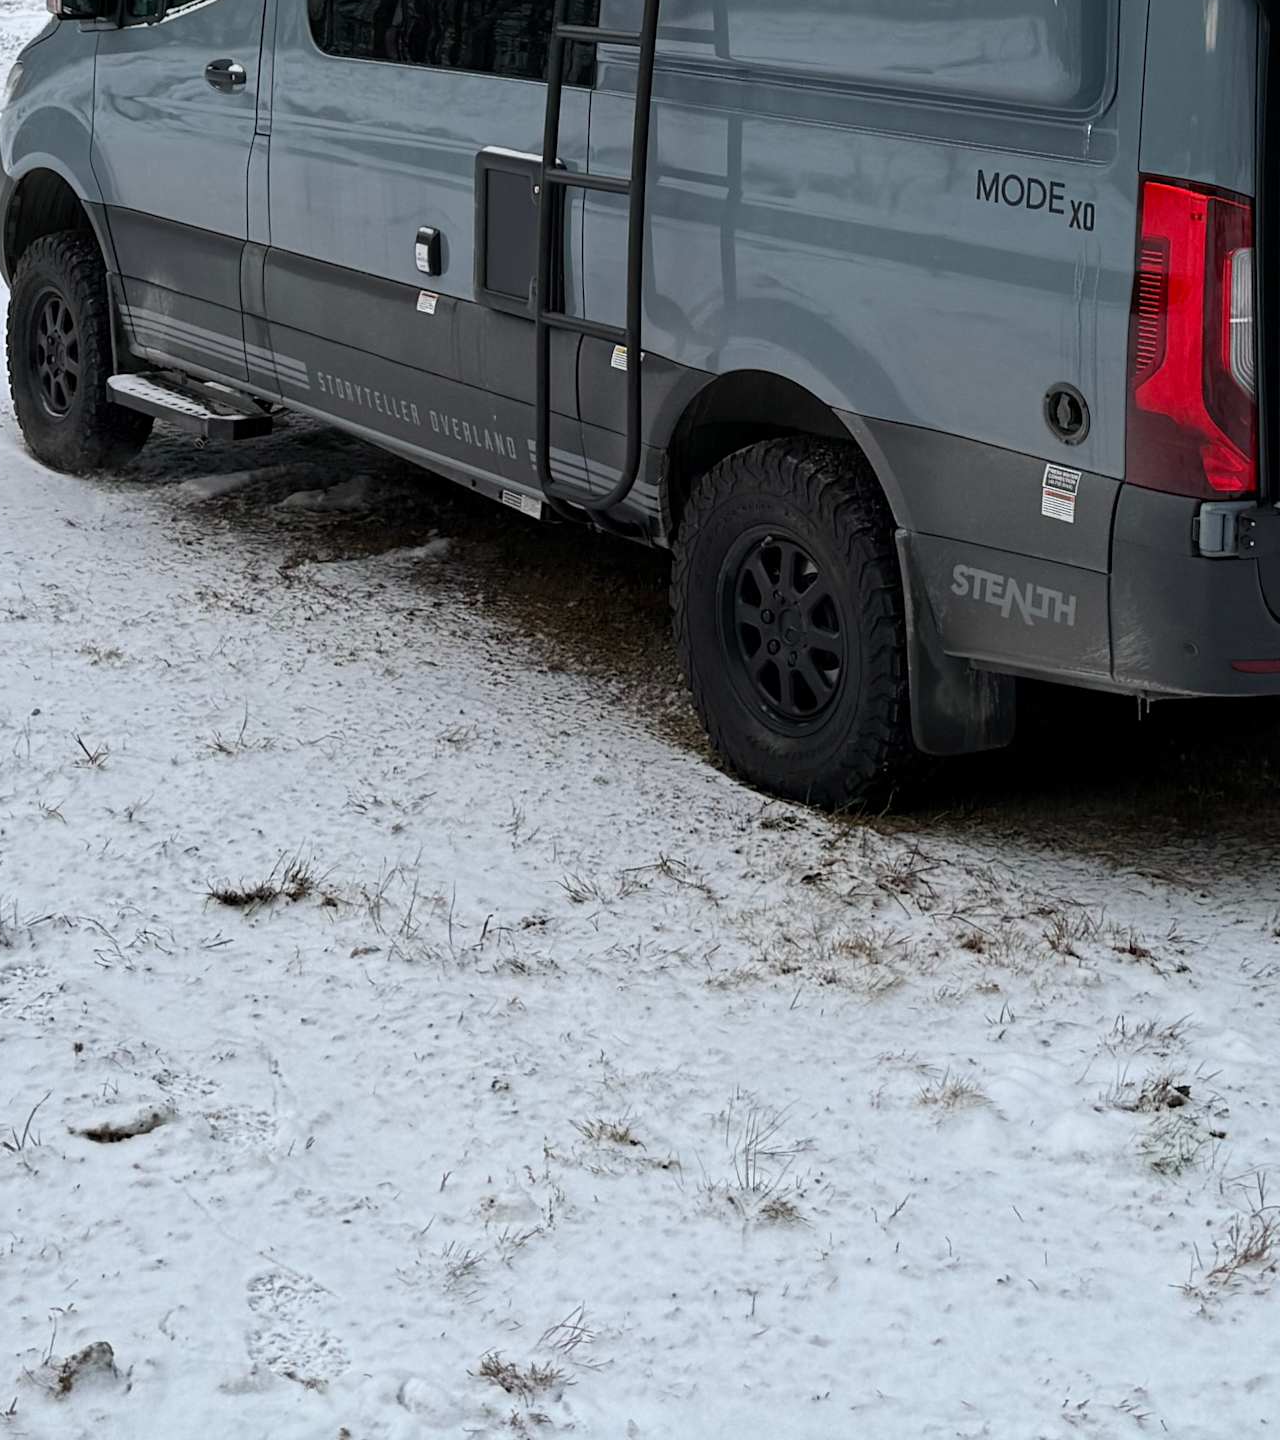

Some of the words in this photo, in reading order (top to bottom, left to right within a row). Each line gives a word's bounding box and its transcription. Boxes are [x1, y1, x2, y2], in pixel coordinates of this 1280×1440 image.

[976, 169, 1065, 215] MODE
[318, 371, 421, 426] STORYTELLER
[429, 410, 517, 460] OVERLAND
[951, 564, 1077, 627] STEALTH
